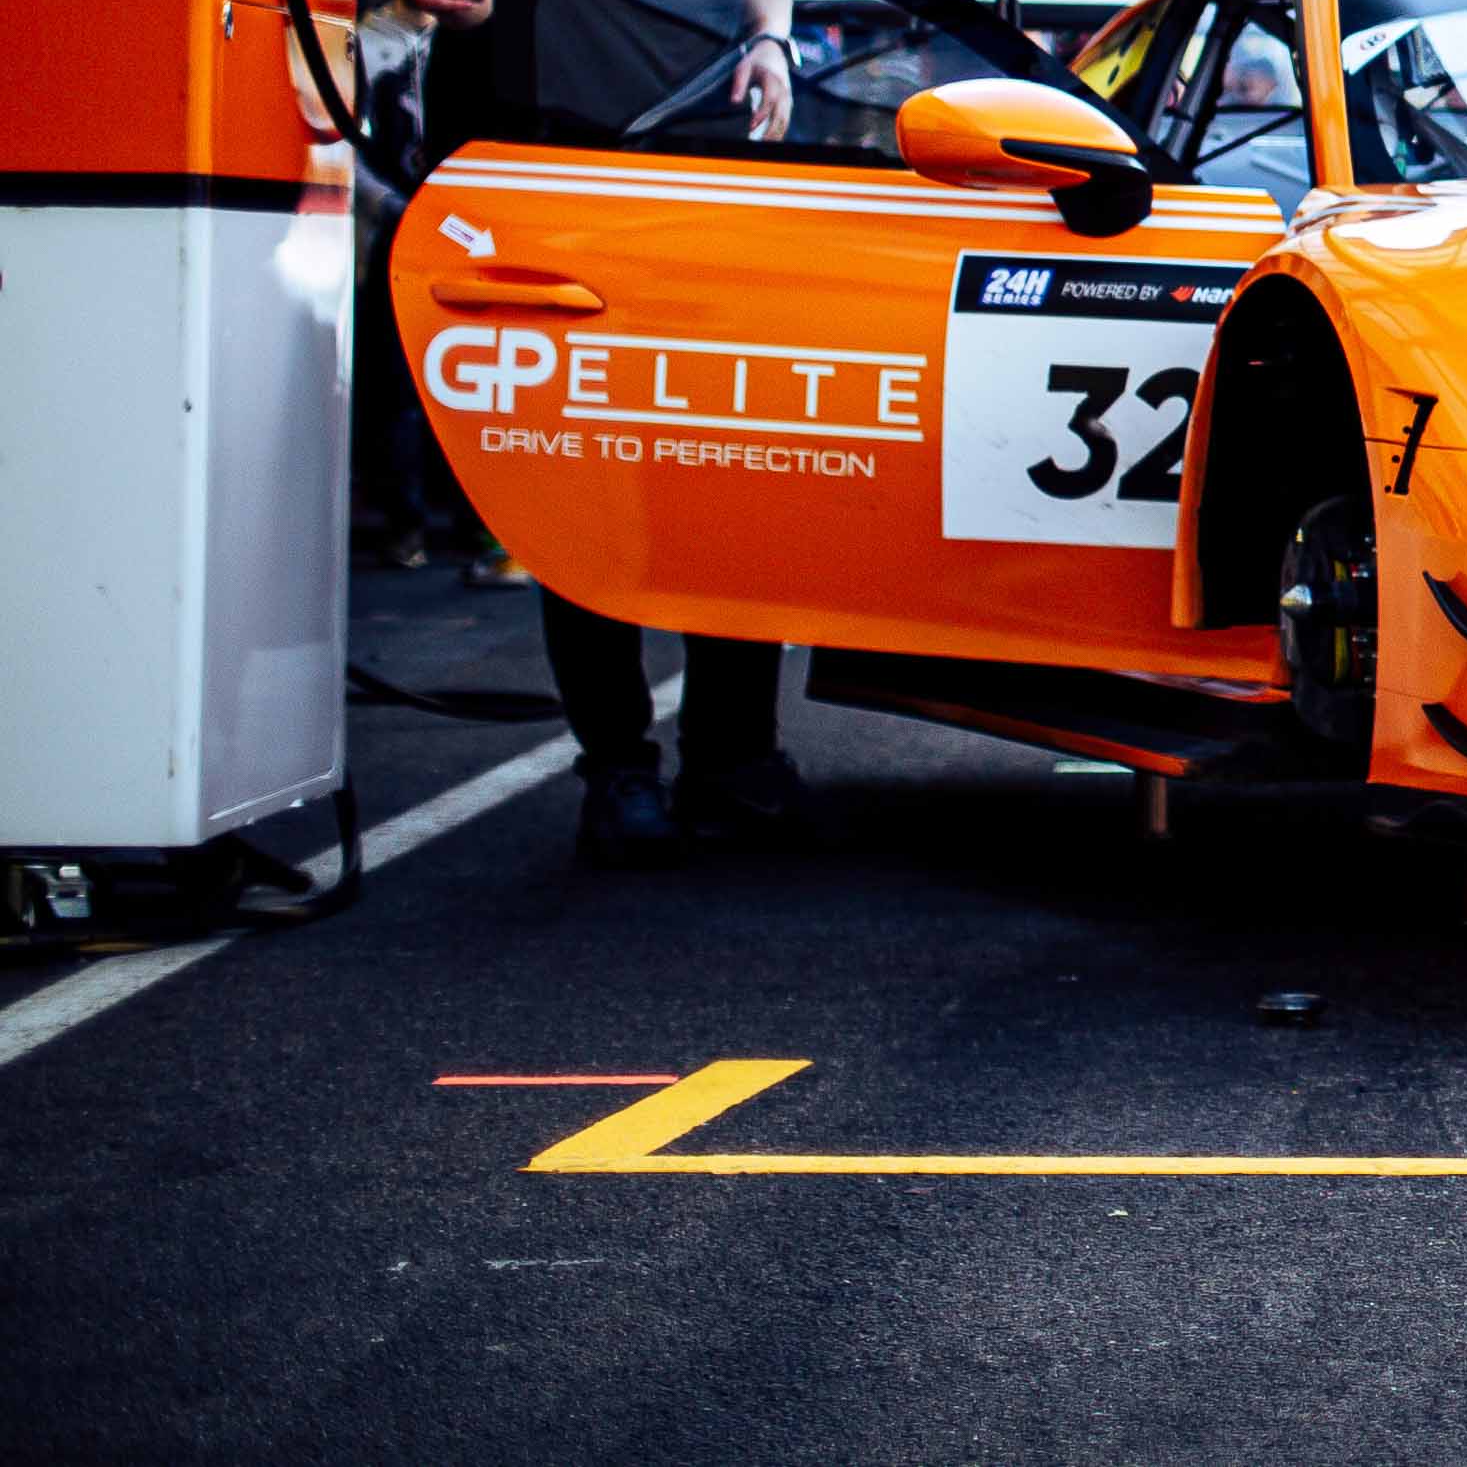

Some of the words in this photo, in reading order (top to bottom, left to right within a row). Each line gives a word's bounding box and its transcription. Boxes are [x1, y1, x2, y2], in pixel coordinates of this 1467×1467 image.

[988, 269, 1050, 293] 24H
[1061, 282, 1136, 300] POWERED
[1140, 284, 1164, 300] BY
[982, 293, 1042, 306] SERIES
[1026, 362, 1200, 502] 32
[480, 427, 582, 459] DRIVE
[594, 433, 643, 462] TO
[653, 437, 876, 478] PERFECTION
